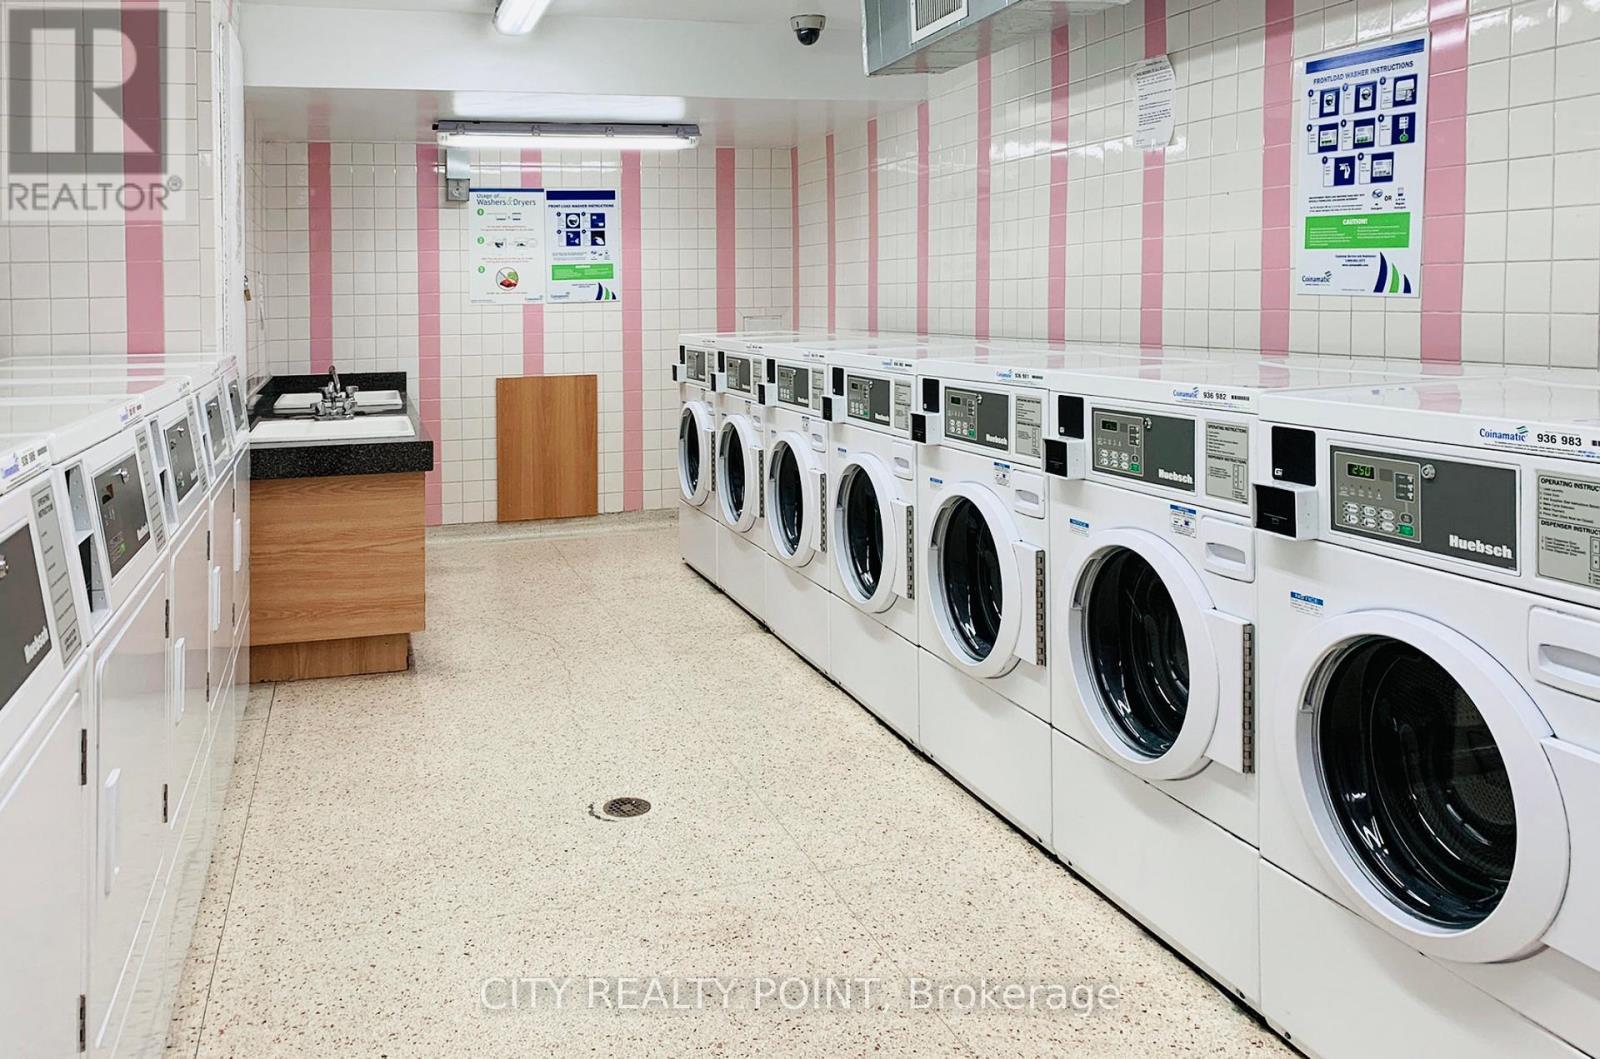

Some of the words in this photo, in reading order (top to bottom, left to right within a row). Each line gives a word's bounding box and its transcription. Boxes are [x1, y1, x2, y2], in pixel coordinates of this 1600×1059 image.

[1345, 68, 1369, 79] WASHER
[1370, 61, 1414, 74] INSTRUCTIONS
[512, 199, 537, 207] Dryers
[1302, 275, 1330, 283] Coinamatic
[1203, 391, 1214, 399] 936
[1479, 427, 1525, 442] Coinamatic
[1537, 433, 1557, 444] 936
[1561, 435, 1582, 447] 983
[1158, 468, 1194, 485] Huebsch
[1540, 477, 1573, 489] OPERATING
[1540, 519, 1572, 531] DISPENSER
[1448, 534, 1513, 560] Huebsch
